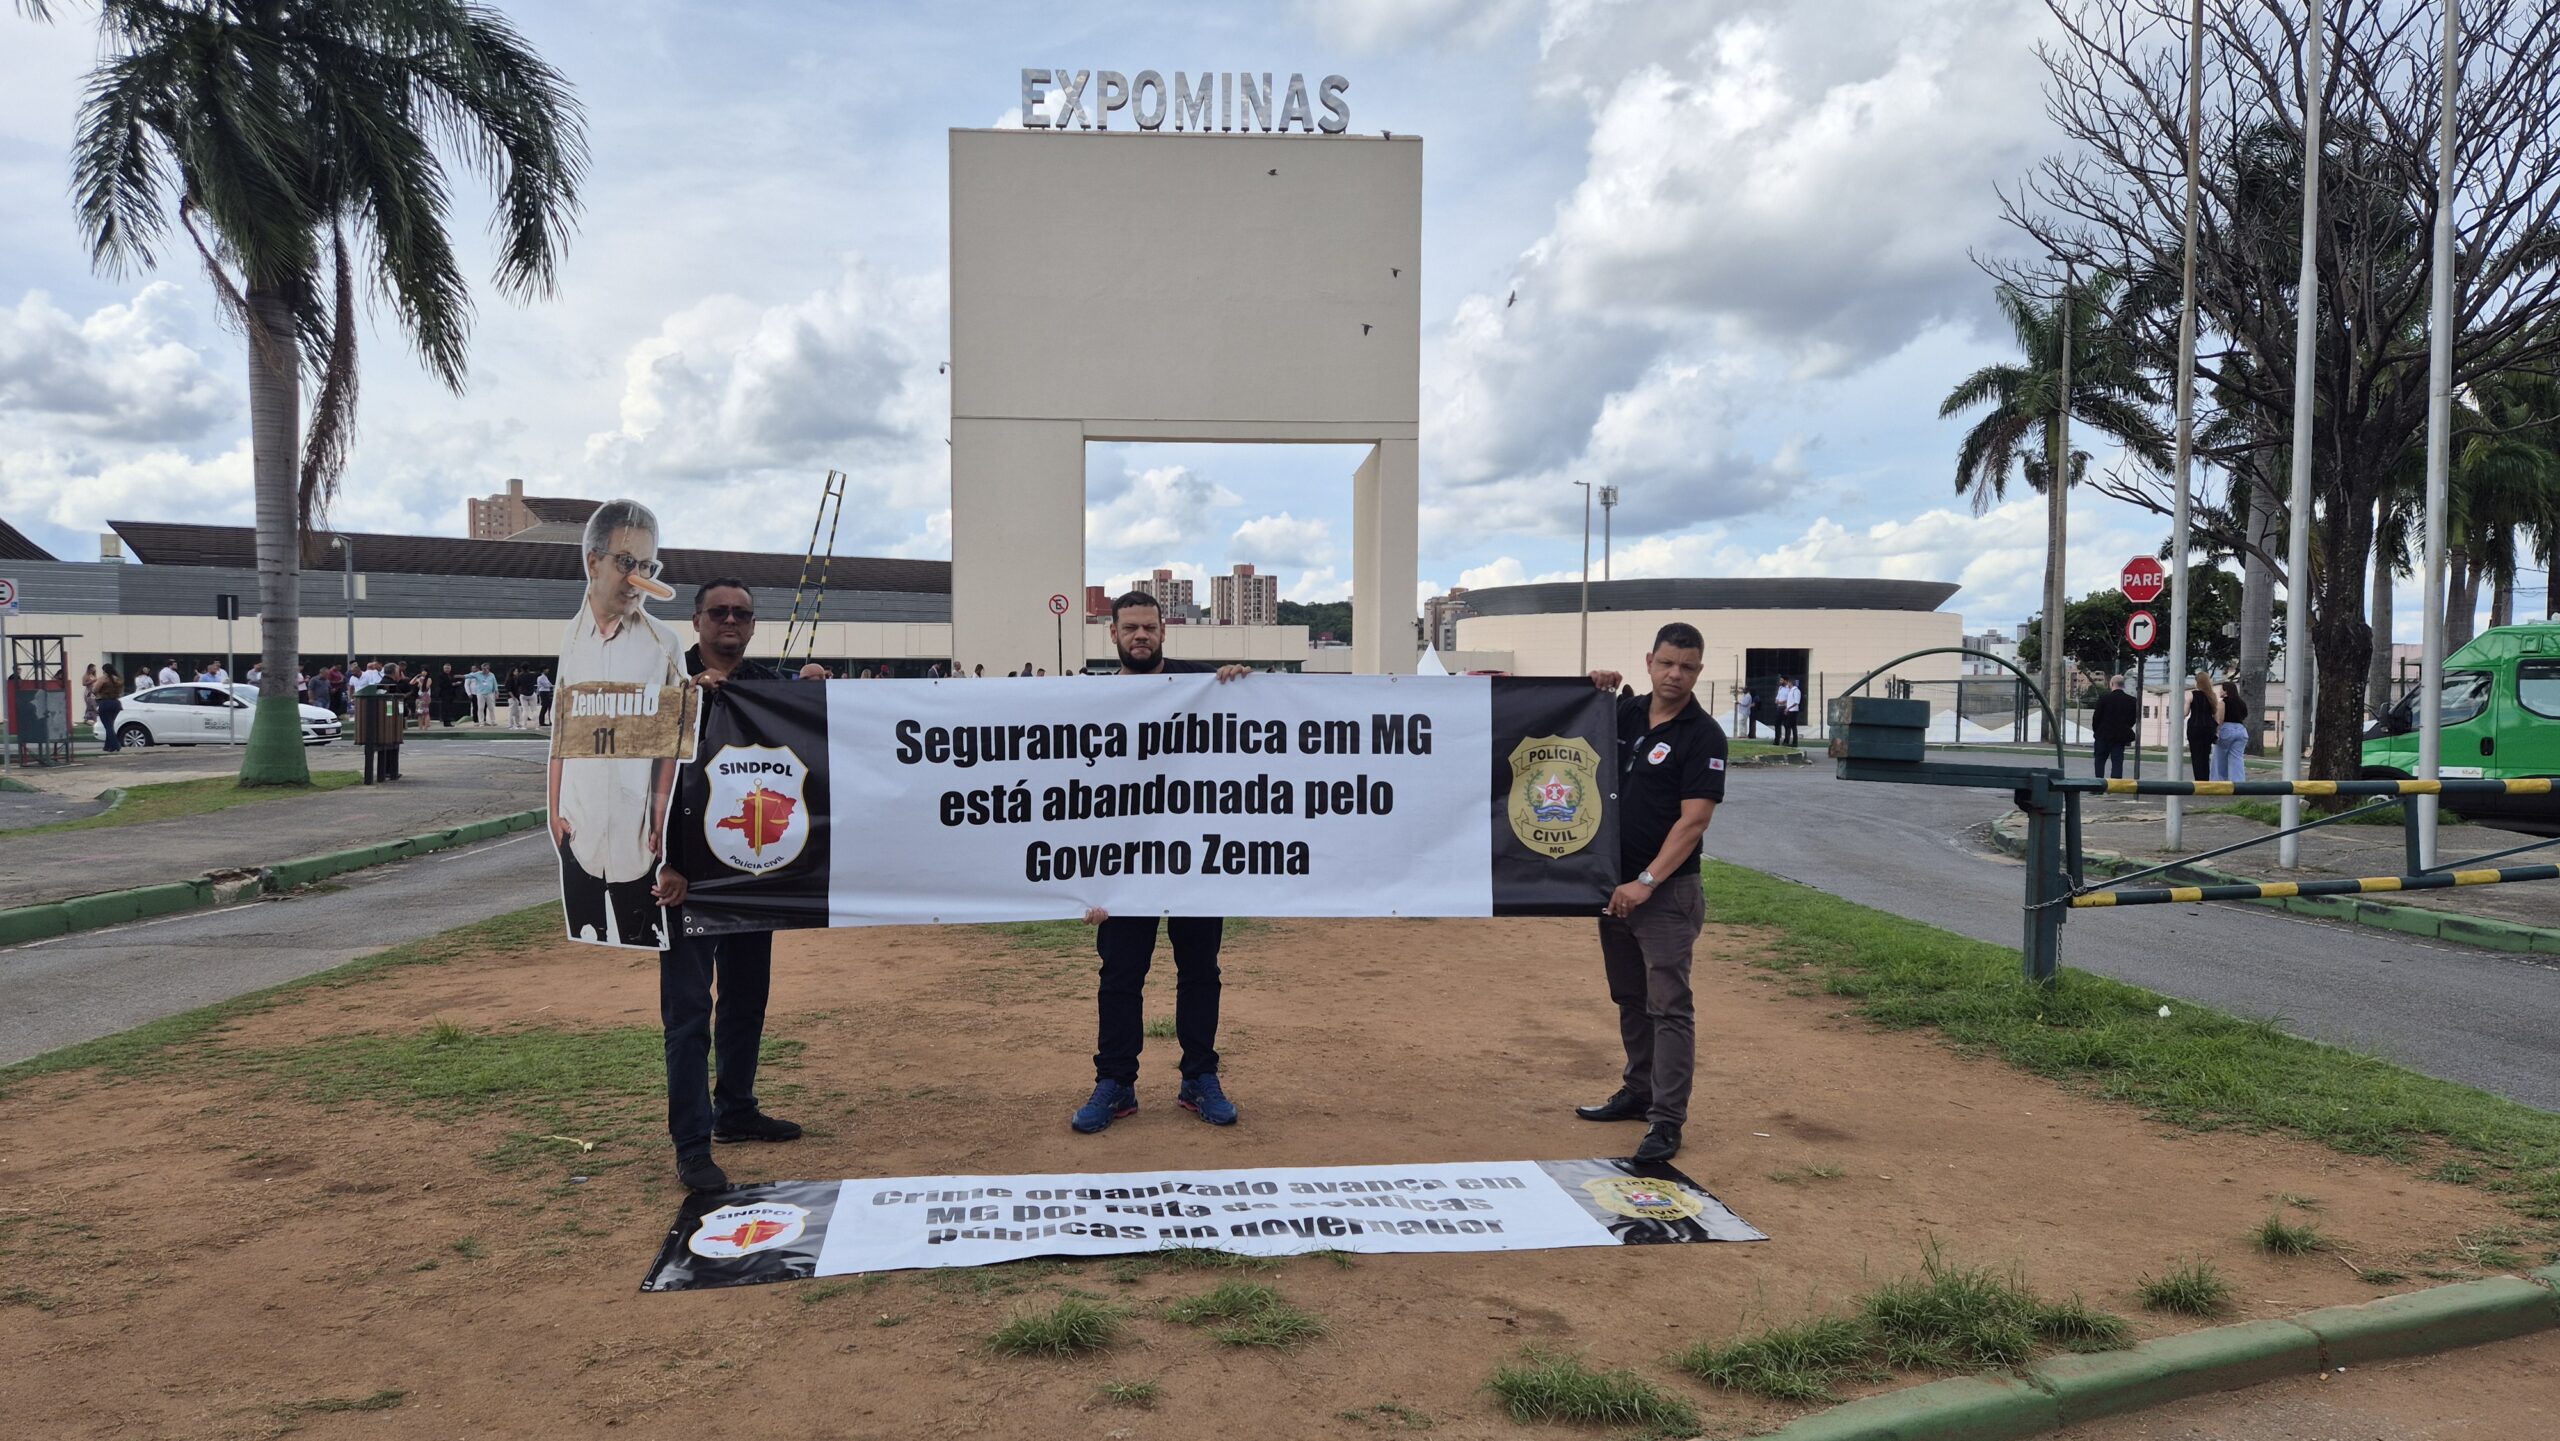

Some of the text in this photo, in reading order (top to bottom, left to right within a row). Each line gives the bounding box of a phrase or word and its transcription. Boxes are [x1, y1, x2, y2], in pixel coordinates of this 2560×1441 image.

[1021, 68, 1350, 133] EXPOMINAS
[2123, 573, 2162, 587] PARE
[593, 727, 616, 754] 171
[896, 712, 1432, 769] Segurança pública em MG
[1529, 747, 1582, 763] POLÍCIA
[719, 761, 793, 777] SINDPOL
[940, 773, 1394, 827] está abandonada pelo
[1533, 829, 1577, 842] CIVIL
[1026, 833, 1310, 883] Governo Zema
[1549, 846, 1565, 854] MG
[729, 855, 784, 869] POLÍCIA CIVIL
[872, 1176, 1527, 1206] Crime organizado avança em
[926, 1204, 999, 1225] MG
[1013, 1204, 1092, 1223] por
